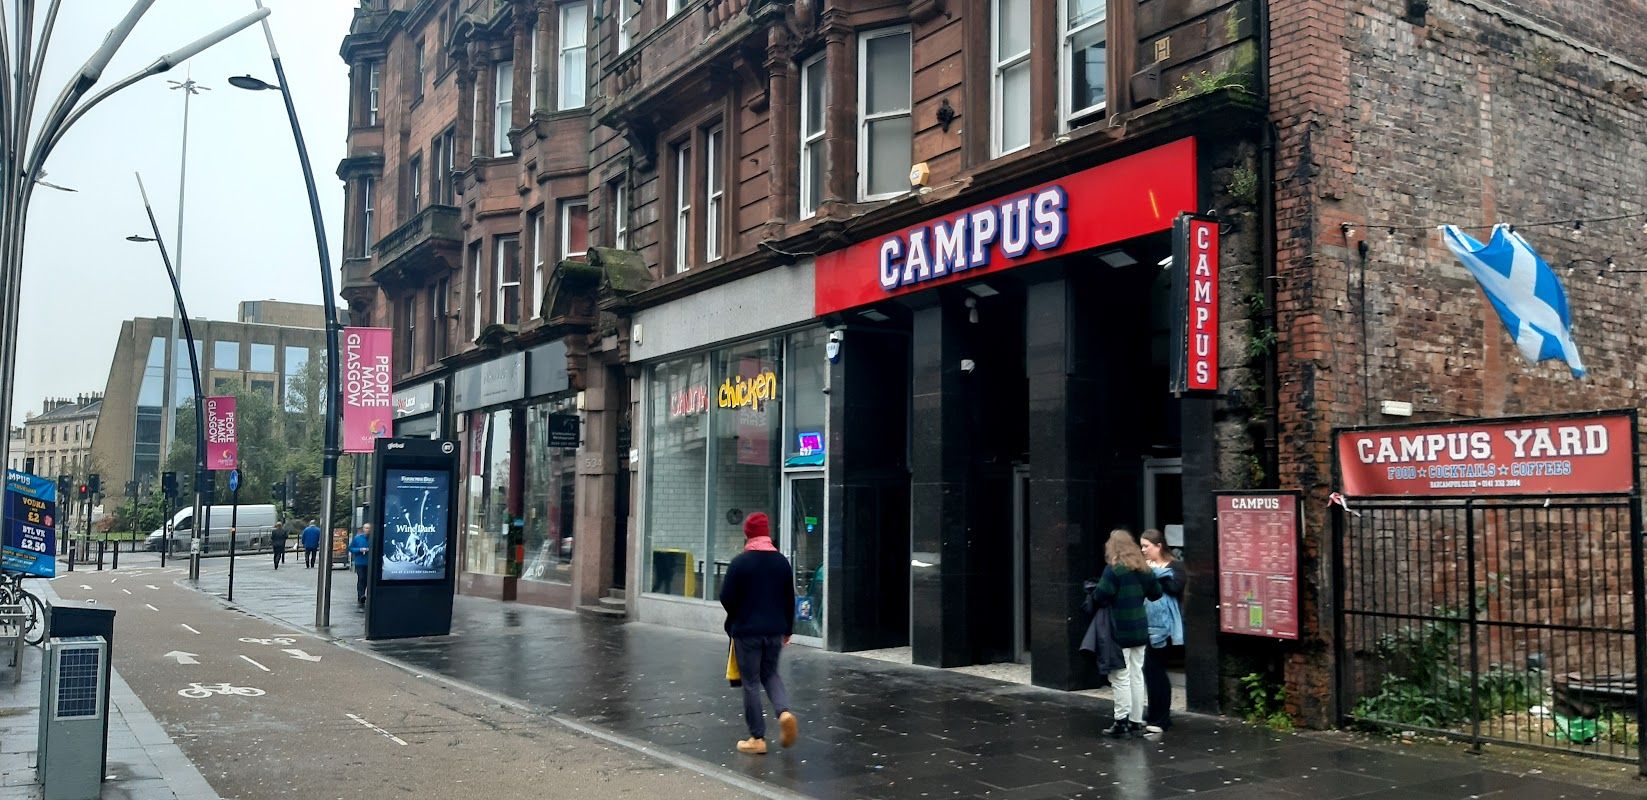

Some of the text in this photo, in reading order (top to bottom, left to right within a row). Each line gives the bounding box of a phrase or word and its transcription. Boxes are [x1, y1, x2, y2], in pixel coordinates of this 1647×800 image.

[879, 185, 1067, 291] CAMPUS
[1194, 225, 1212, 385] CAMPUS
[347, 333, 361, 407] GLASGOW
[361, 366, 375, 407] MAKE
[376, 355, 389, 407] PEOPLE
[718, 371, 777, 410] chicken
[208, 400, 218, 444] GLASGOW
[217, 418, 226, 443] MAKE
[225, 411, 235, 443] PEOPLE
[1357, 423, 1609, 464] CAMPUS YARD
[1387, 460, 1572, 480] FOOD COCKTAILS COFFEES
[22, 496, 46, 509] VODKA
[27, 511, 40, 523] £2
[1231, 498, 1280, 509] CAMPUS
[21, 539, 46, 552] £2.50
